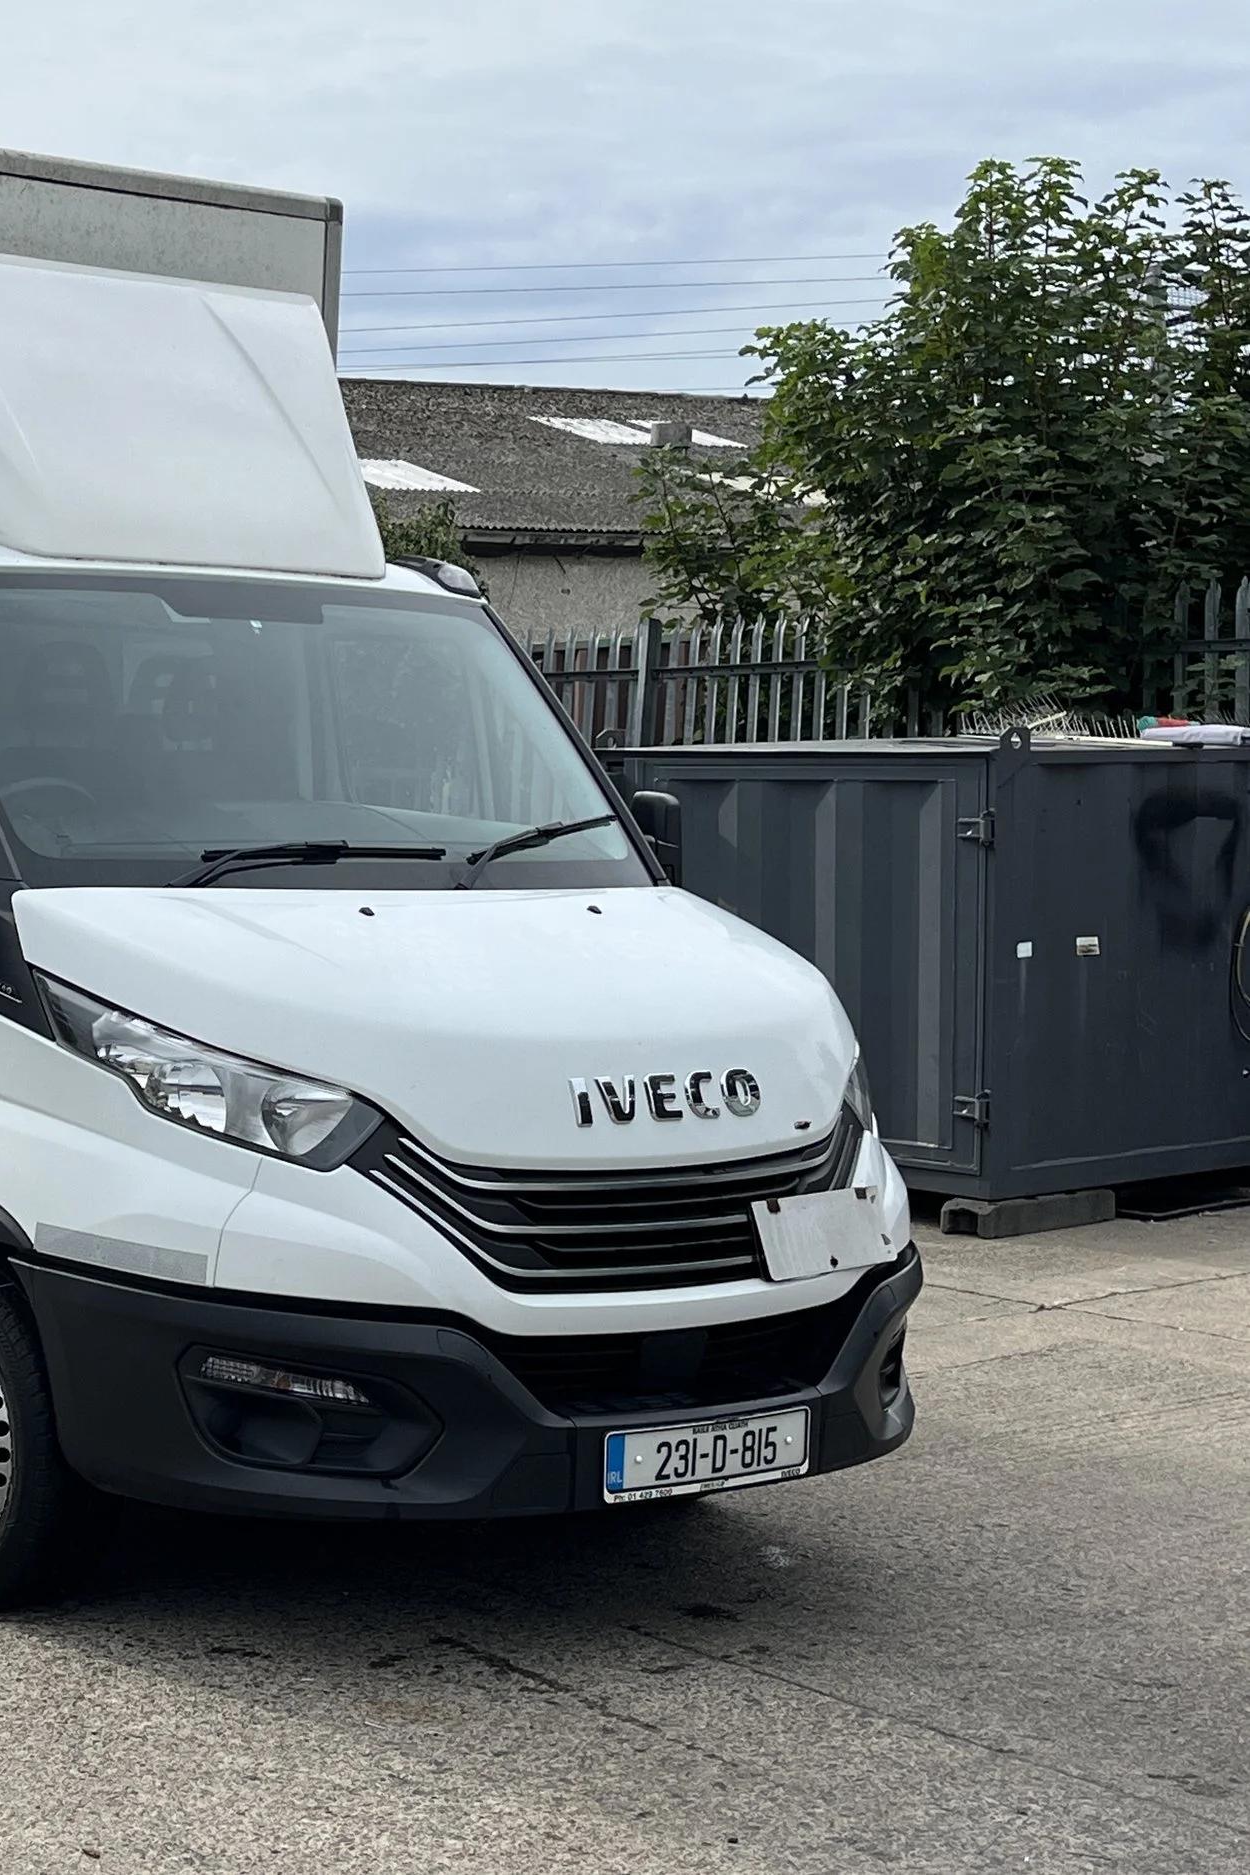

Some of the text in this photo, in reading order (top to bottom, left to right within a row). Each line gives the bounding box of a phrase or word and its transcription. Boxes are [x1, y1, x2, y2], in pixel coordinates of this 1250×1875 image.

[568, 1067, 761, 1127] IVECO
[607, 1470, 623, 1485] IRL
[654, 1426, 777, 1481] 231-D-815
